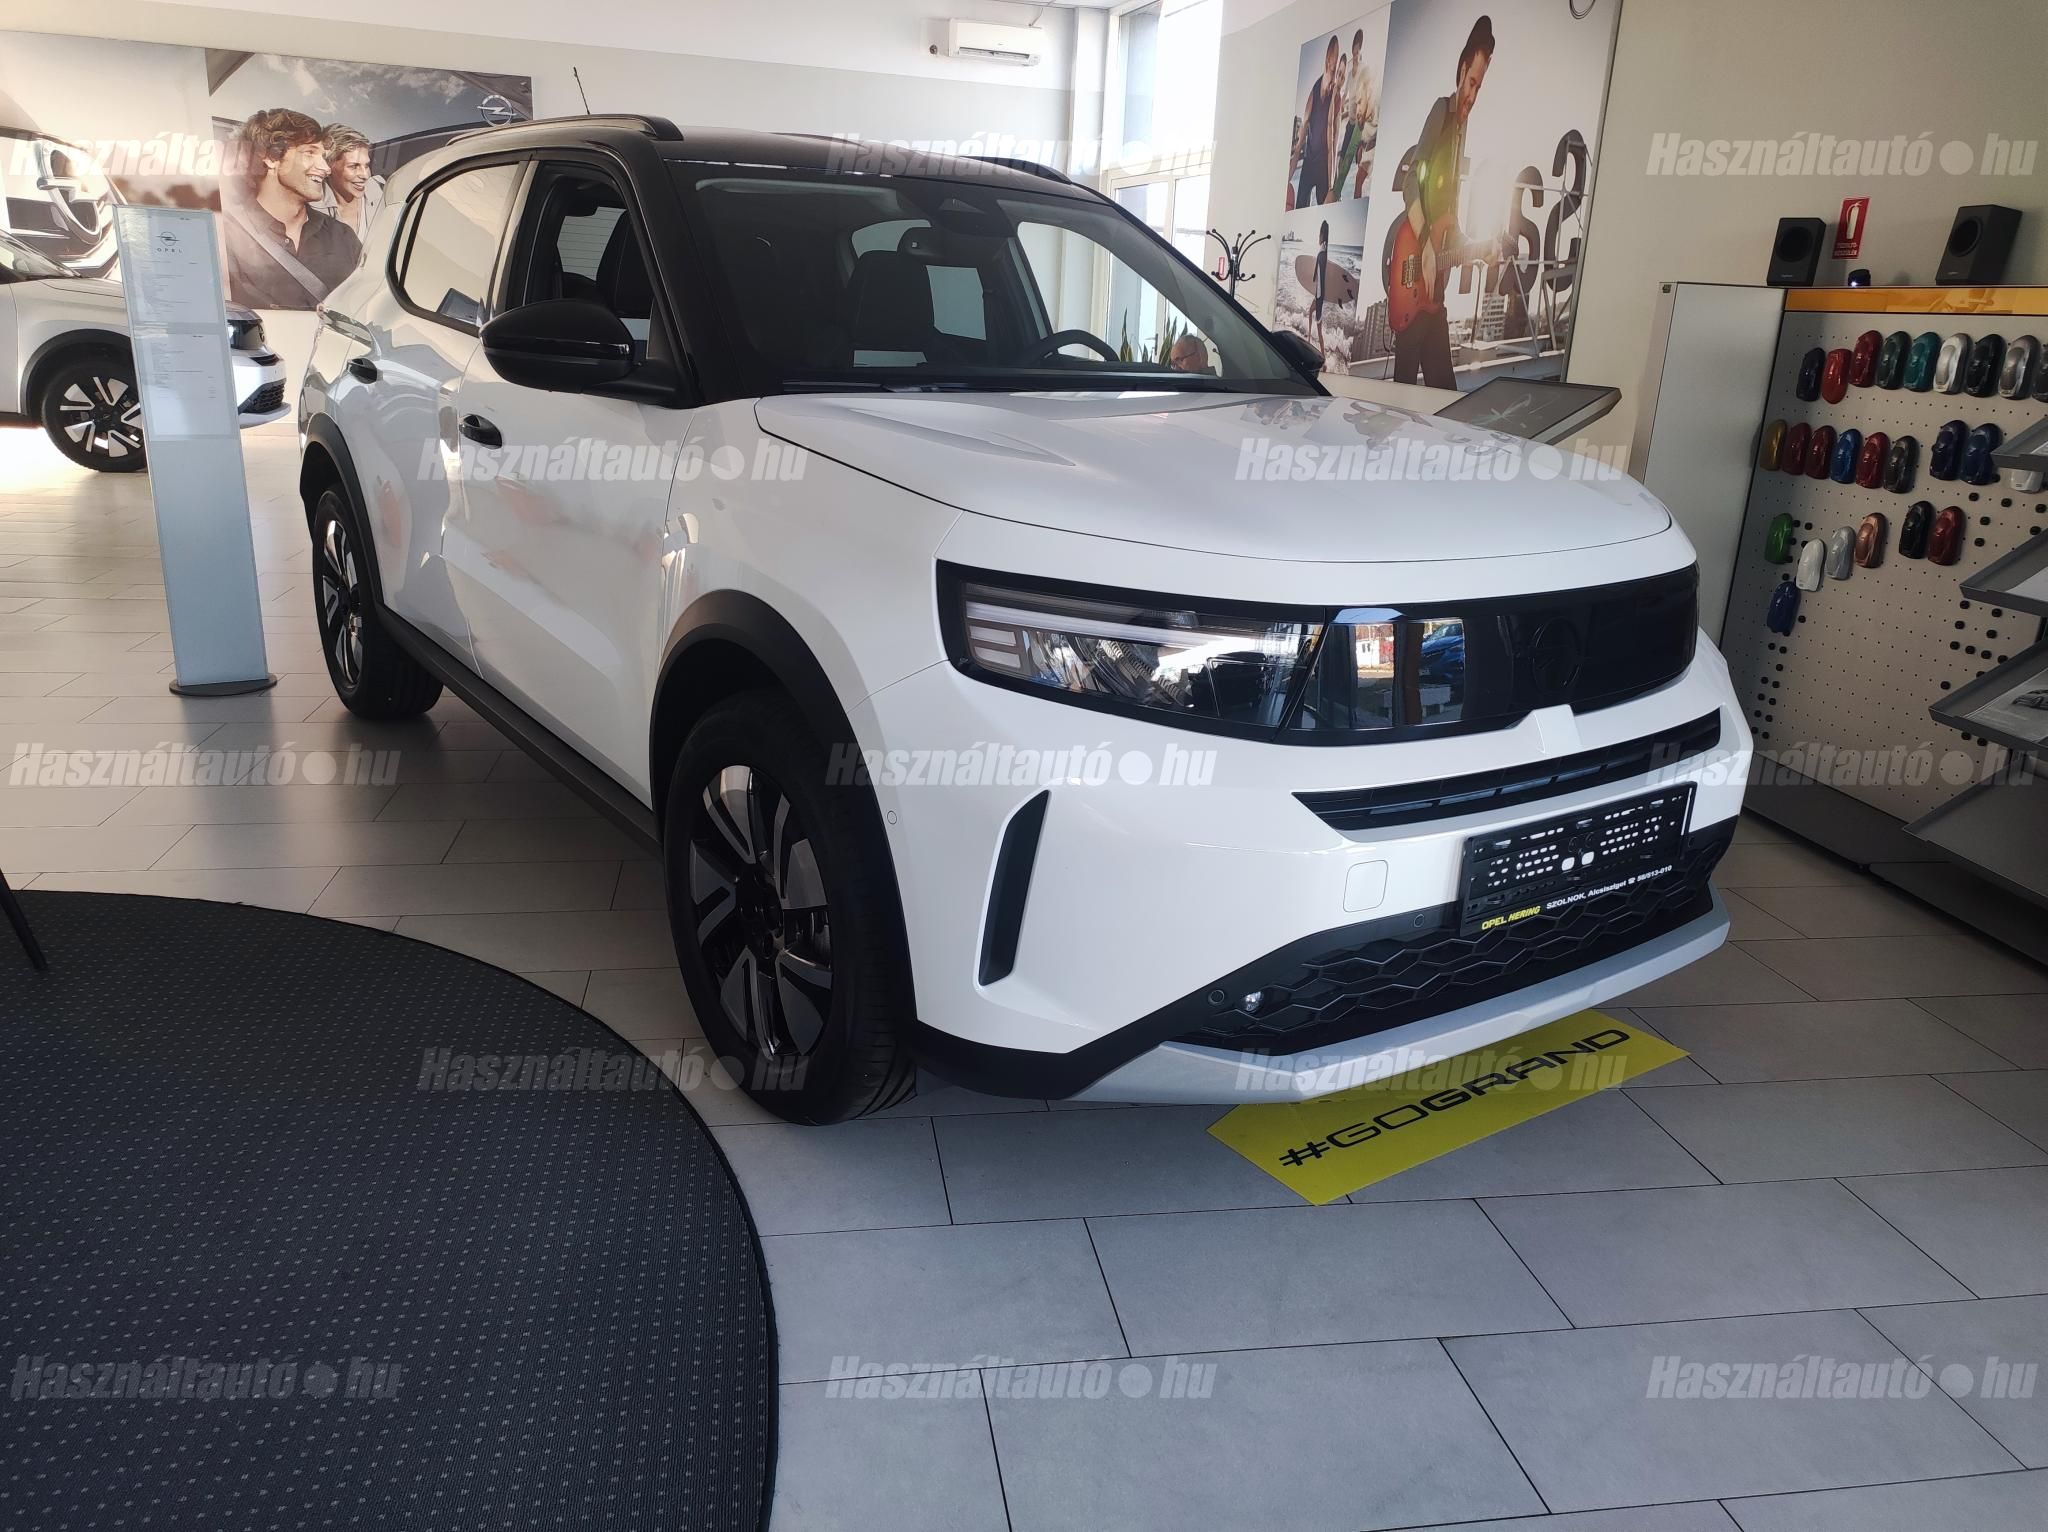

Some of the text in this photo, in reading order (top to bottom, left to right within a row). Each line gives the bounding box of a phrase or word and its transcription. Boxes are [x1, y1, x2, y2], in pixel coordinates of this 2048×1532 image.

[1481, 916, 1507, 930] OPEL
[1508, 905, 1541, 922] HERING
[1546, 892, 1587, 910] SZOLNOK,
[1279, 1029, 1631, 1167] #GOGRAND
